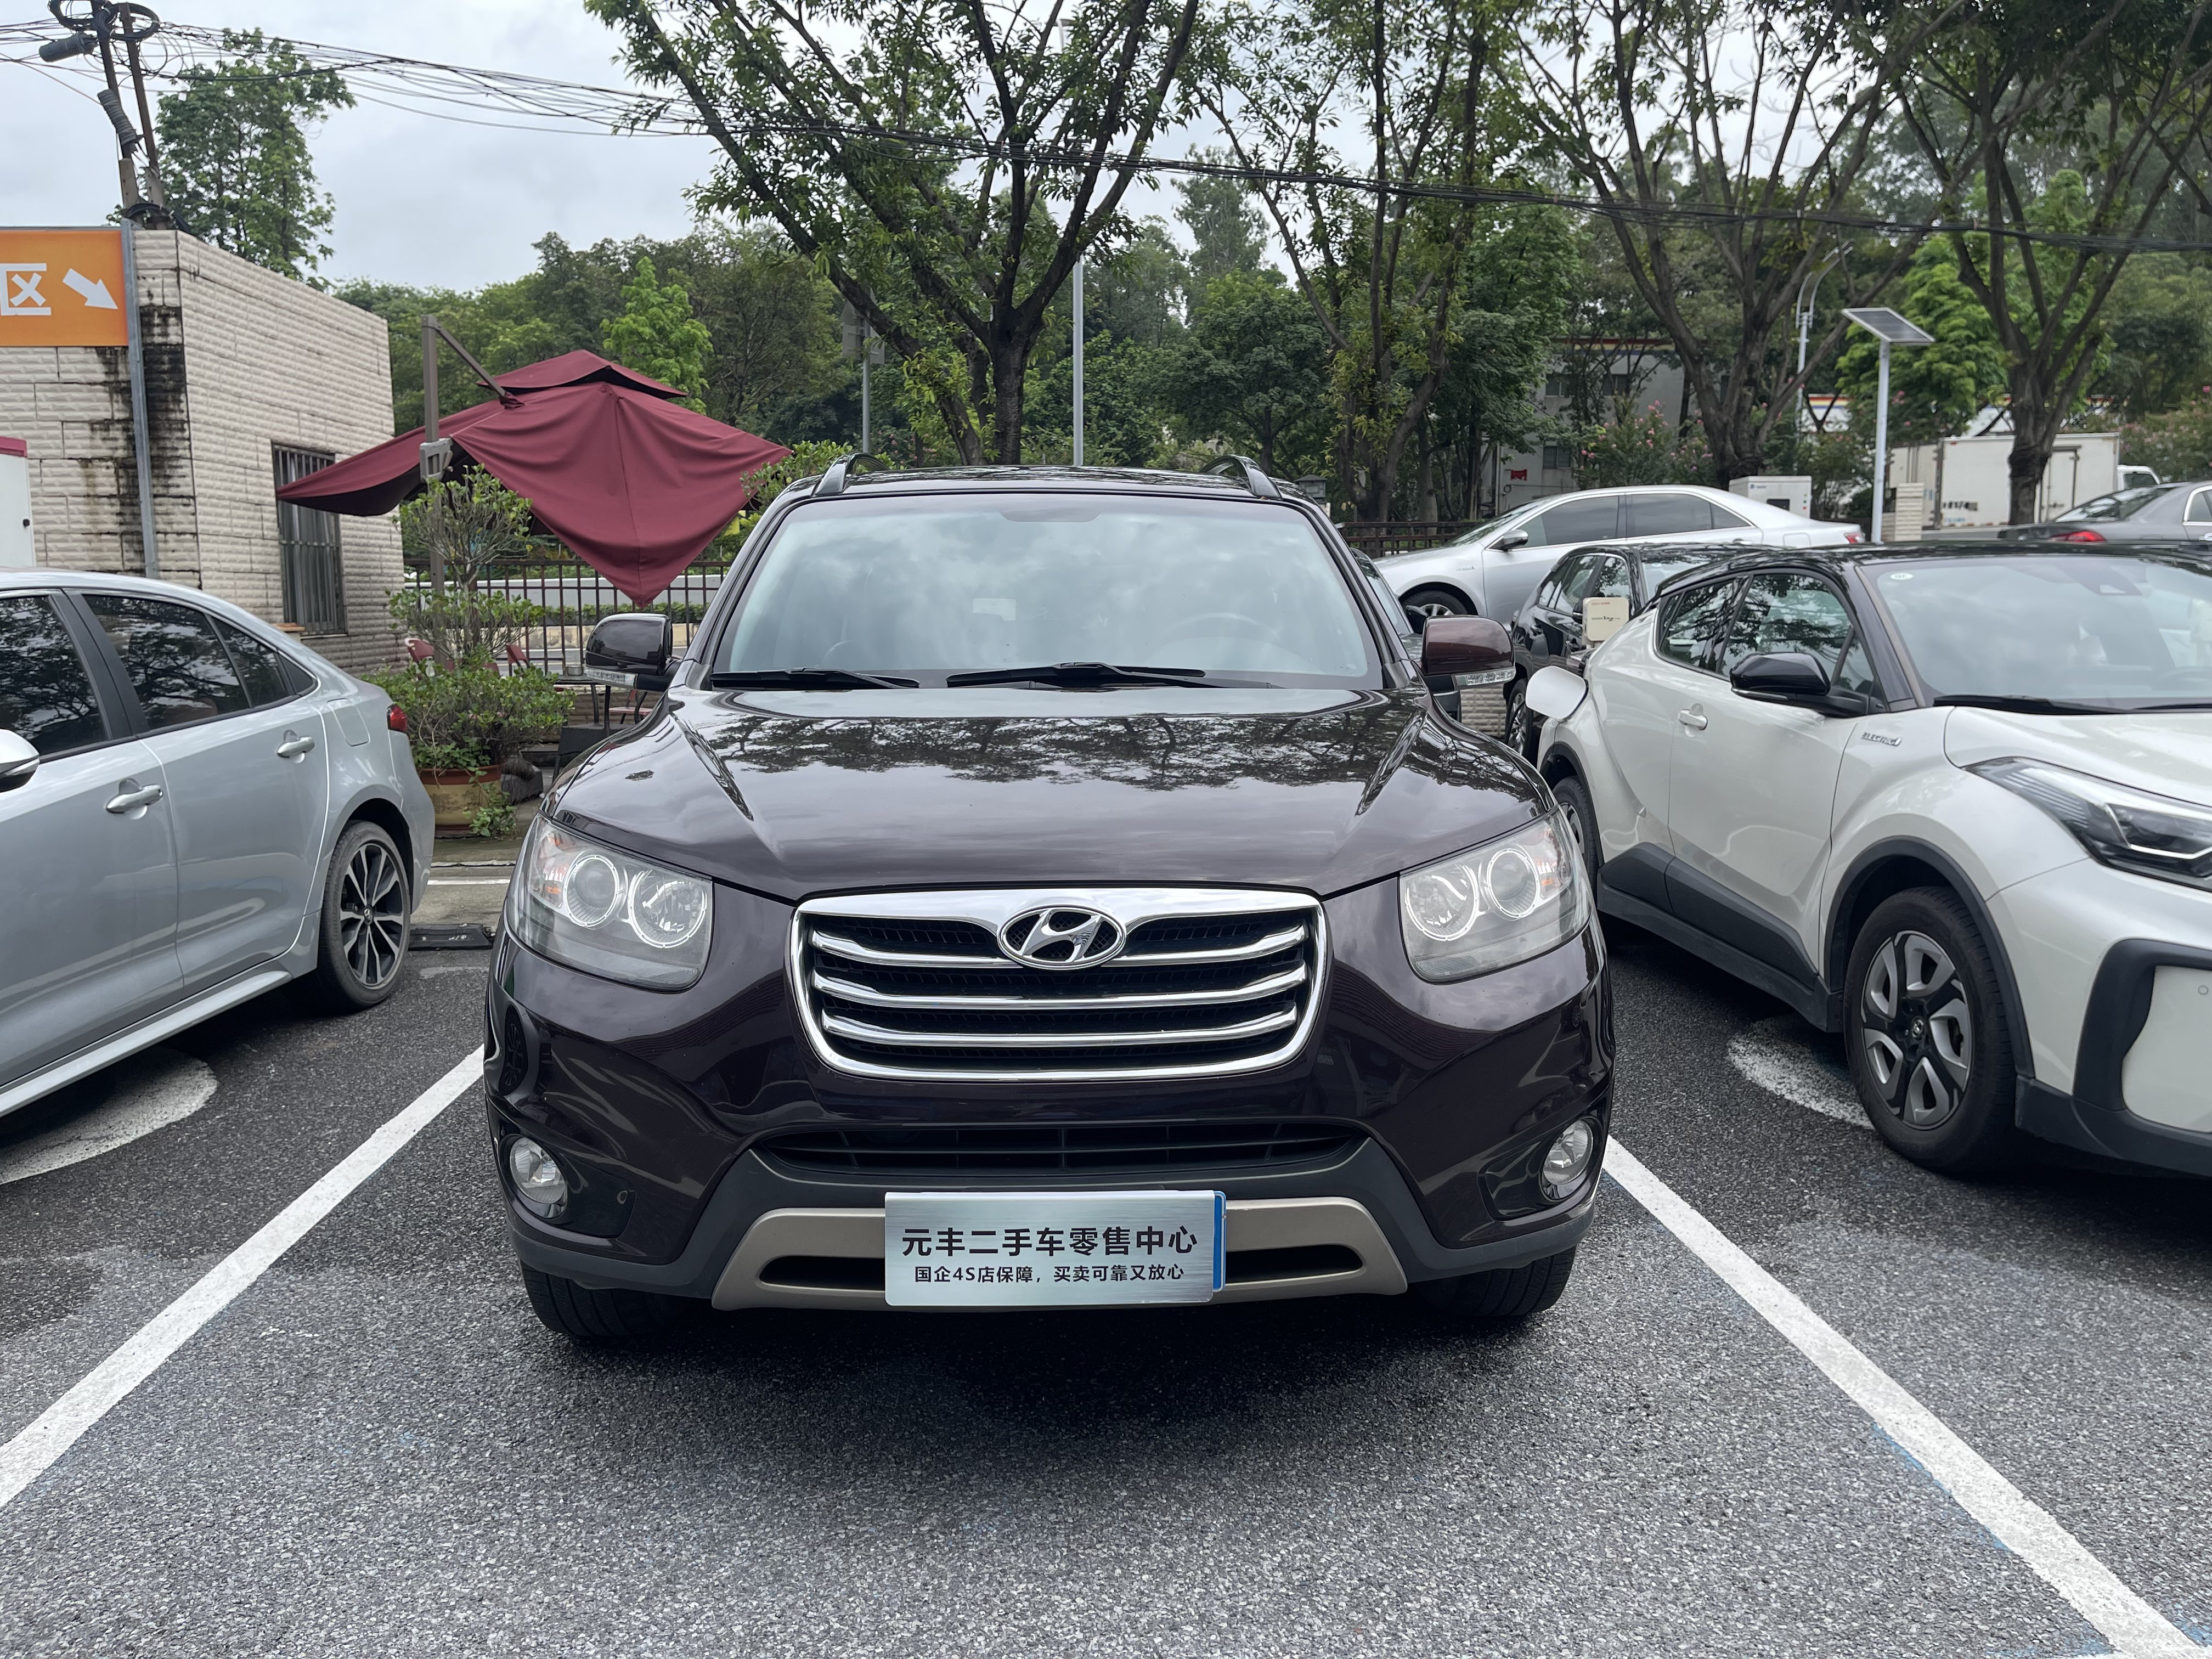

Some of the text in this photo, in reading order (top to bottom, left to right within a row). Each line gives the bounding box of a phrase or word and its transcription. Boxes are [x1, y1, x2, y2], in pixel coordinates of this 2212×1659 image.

[0, 263, 52, 316] 区
[902, 1225, 1198, 1257] 元丰二手车零售中心
